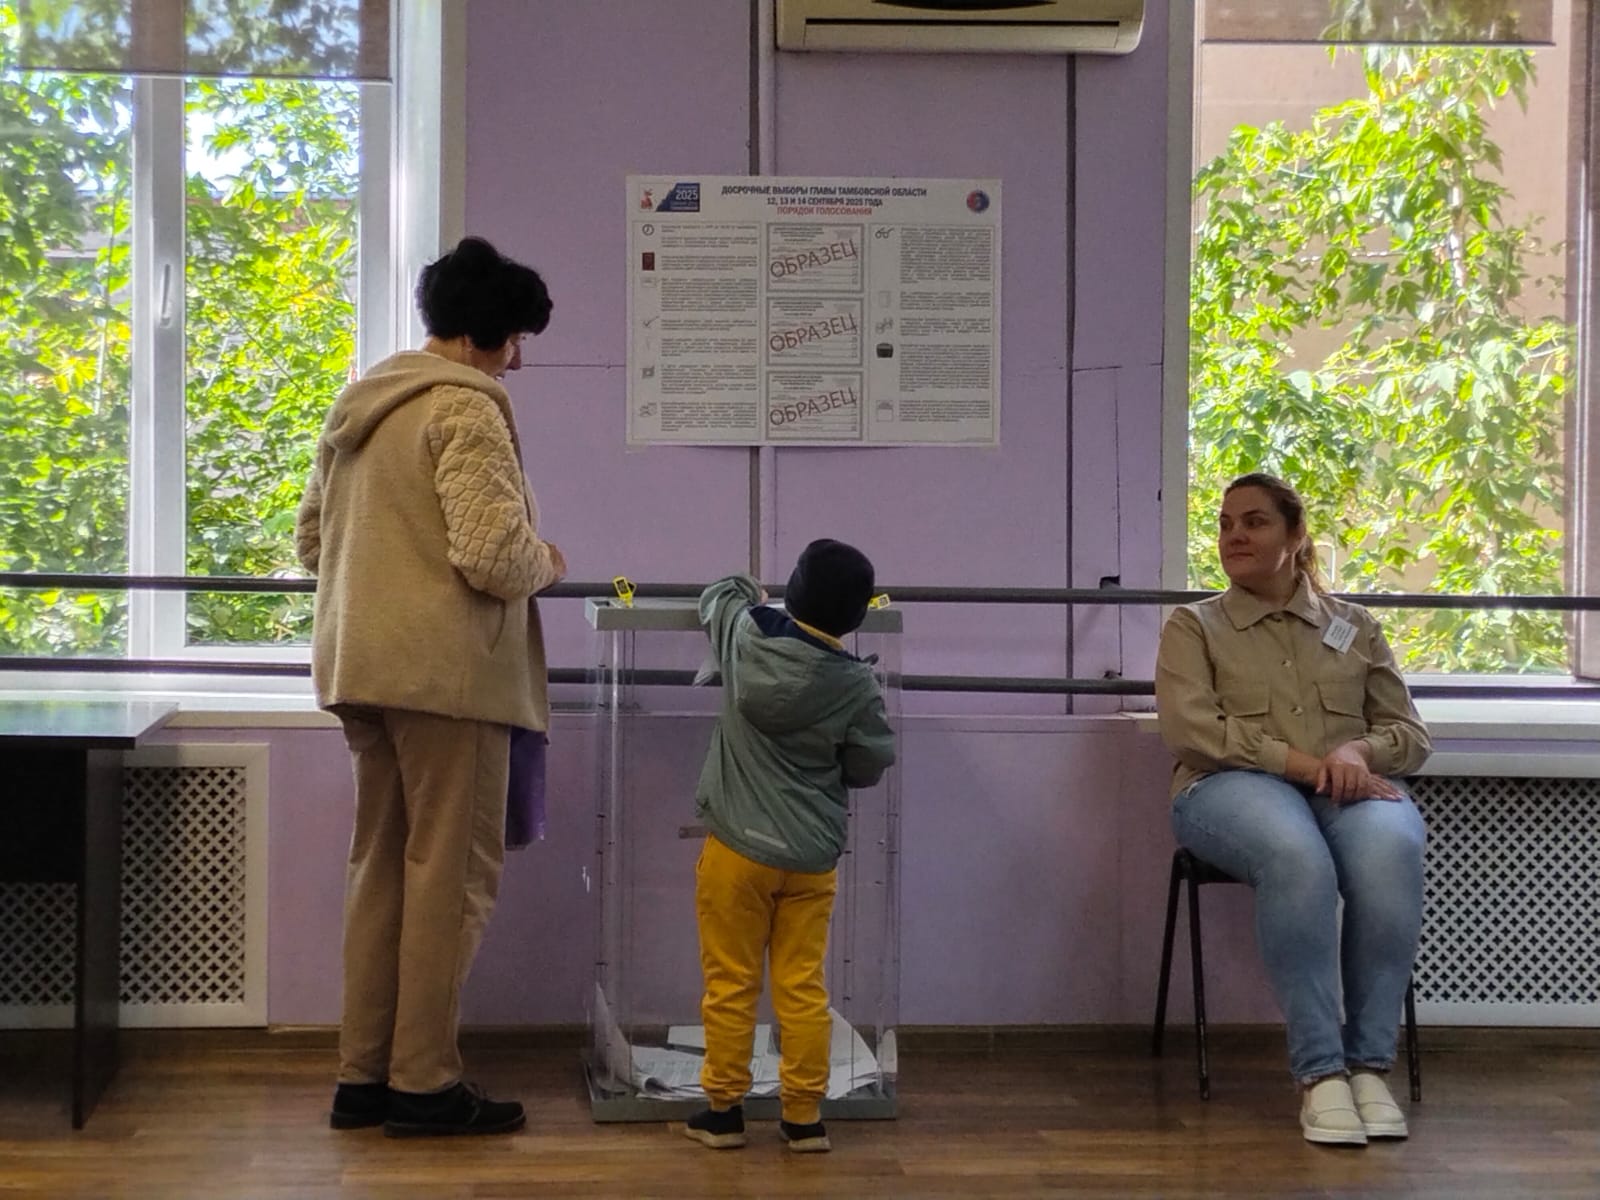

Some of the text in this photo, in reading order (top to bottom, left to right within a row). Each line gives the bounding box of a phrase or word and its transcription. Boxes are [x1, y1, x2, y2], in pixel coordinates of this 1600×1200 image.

[675, 189, 698, 200] 2025
[722, 185, 927, 196] ДОСРОЧНЫЕ ВЫБОРЫ ГЛАВЫ ТАМБОВСКОЙ ОБЛАСТИ
[767, 197, 778, 206] 12,
[808, 197, 844, 206] СЕНТЯБРЯ
[845, 198, 863, 206] 2025
[865, 198, 883, 207] ГОДА
[777, 206, 872, 216] ПОРЯДОК ГОЛОСОВАНИЯ
[770, 238, 858, 278] ОБРАЗЕЦ
[769, 312, 857, 352] ОБРАЗЕЦ
[769, 386, 857, 426] ОБРАЗЕЦ
